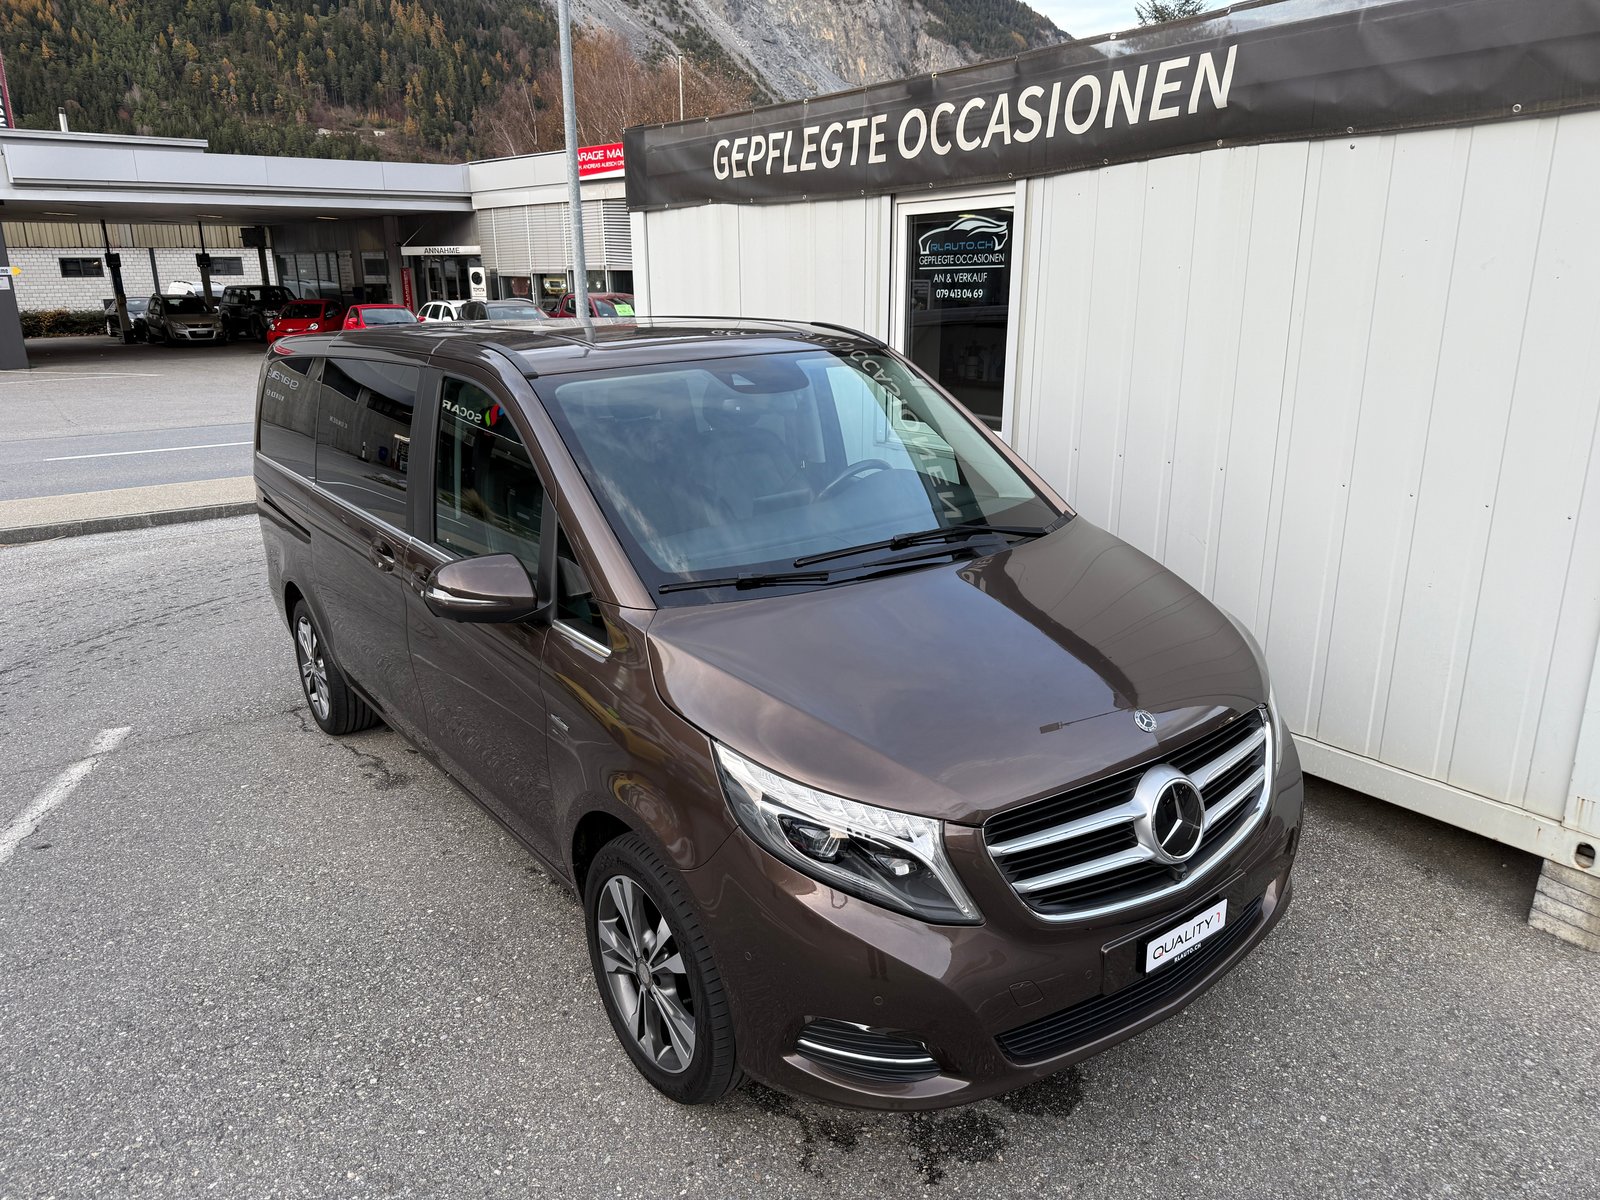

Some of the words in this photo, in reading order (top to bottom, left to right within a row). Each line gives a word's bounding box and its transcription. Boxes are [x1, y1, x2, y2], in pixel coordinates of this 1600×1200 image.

[713, 113, 888, 181] GEPFLEGTE
[897, 44, 1239, 160] OCCASIONEN
[930, 240, 994, 252] RLAUTO.CH
[919, 254, 954, 265] GEPFLEGTE
[955, 253, 1005, 264] OCCASIONEN
[933, 273, 945, 283] AN
[946, 273, 952, 283] &
[953, 272, 988, 283] VERKAUF
[936, 289, 949, 298] 079
[949, 289, 961, 298] 413
[962, 289, 972, 298] 04
[973, 289, 983, 298] 69
[1152, 915, 1214, 960] QUALITY
[1216, 911, 1221, 923] 1
